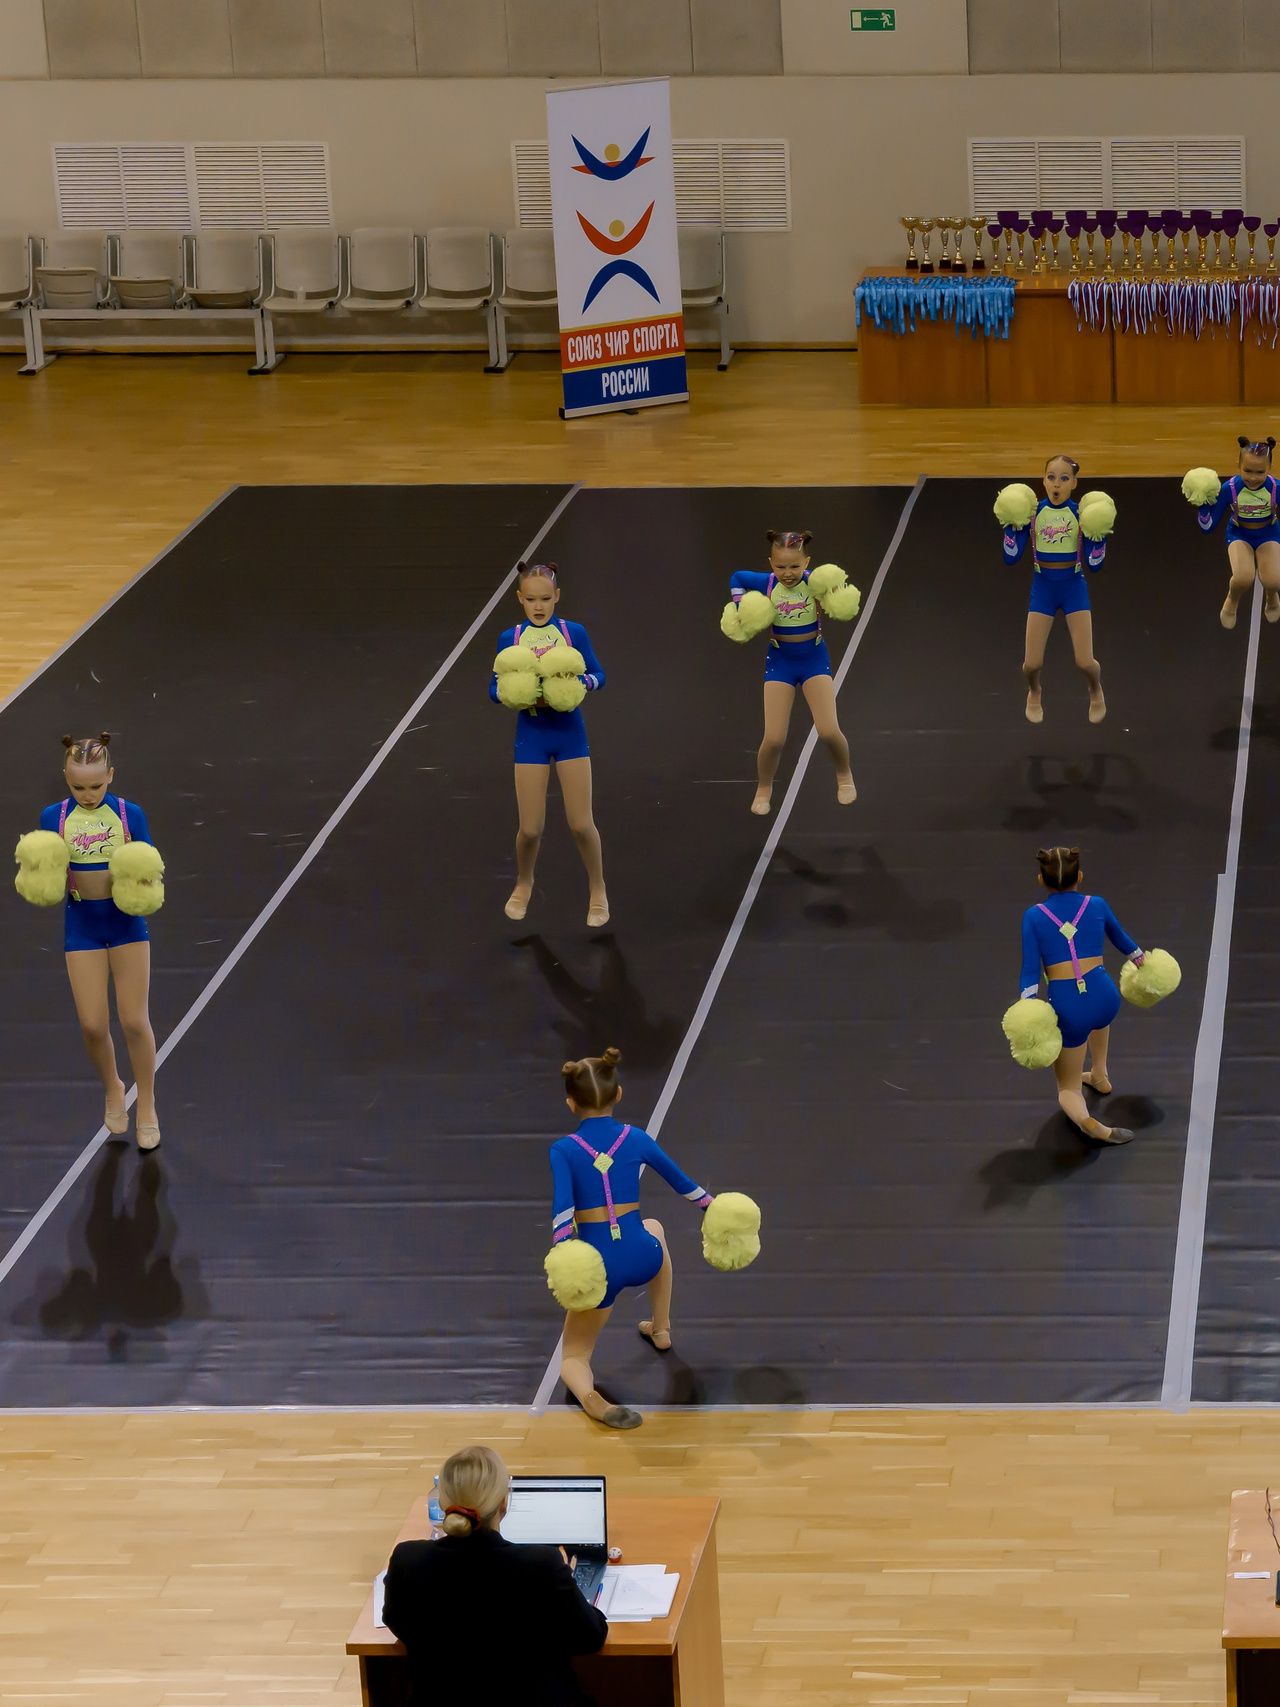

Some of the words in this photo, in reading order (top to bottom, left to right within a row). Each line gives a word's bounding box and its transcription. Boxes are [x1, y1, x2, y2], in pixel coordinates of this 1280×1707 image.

[567, 333, 602, 363] СОЮЗ
[605, 329, 630, 357] ЧИР
[633, 322, 679, 353] СПОРТА
[601, 366, 650, 398] РОССИИ
